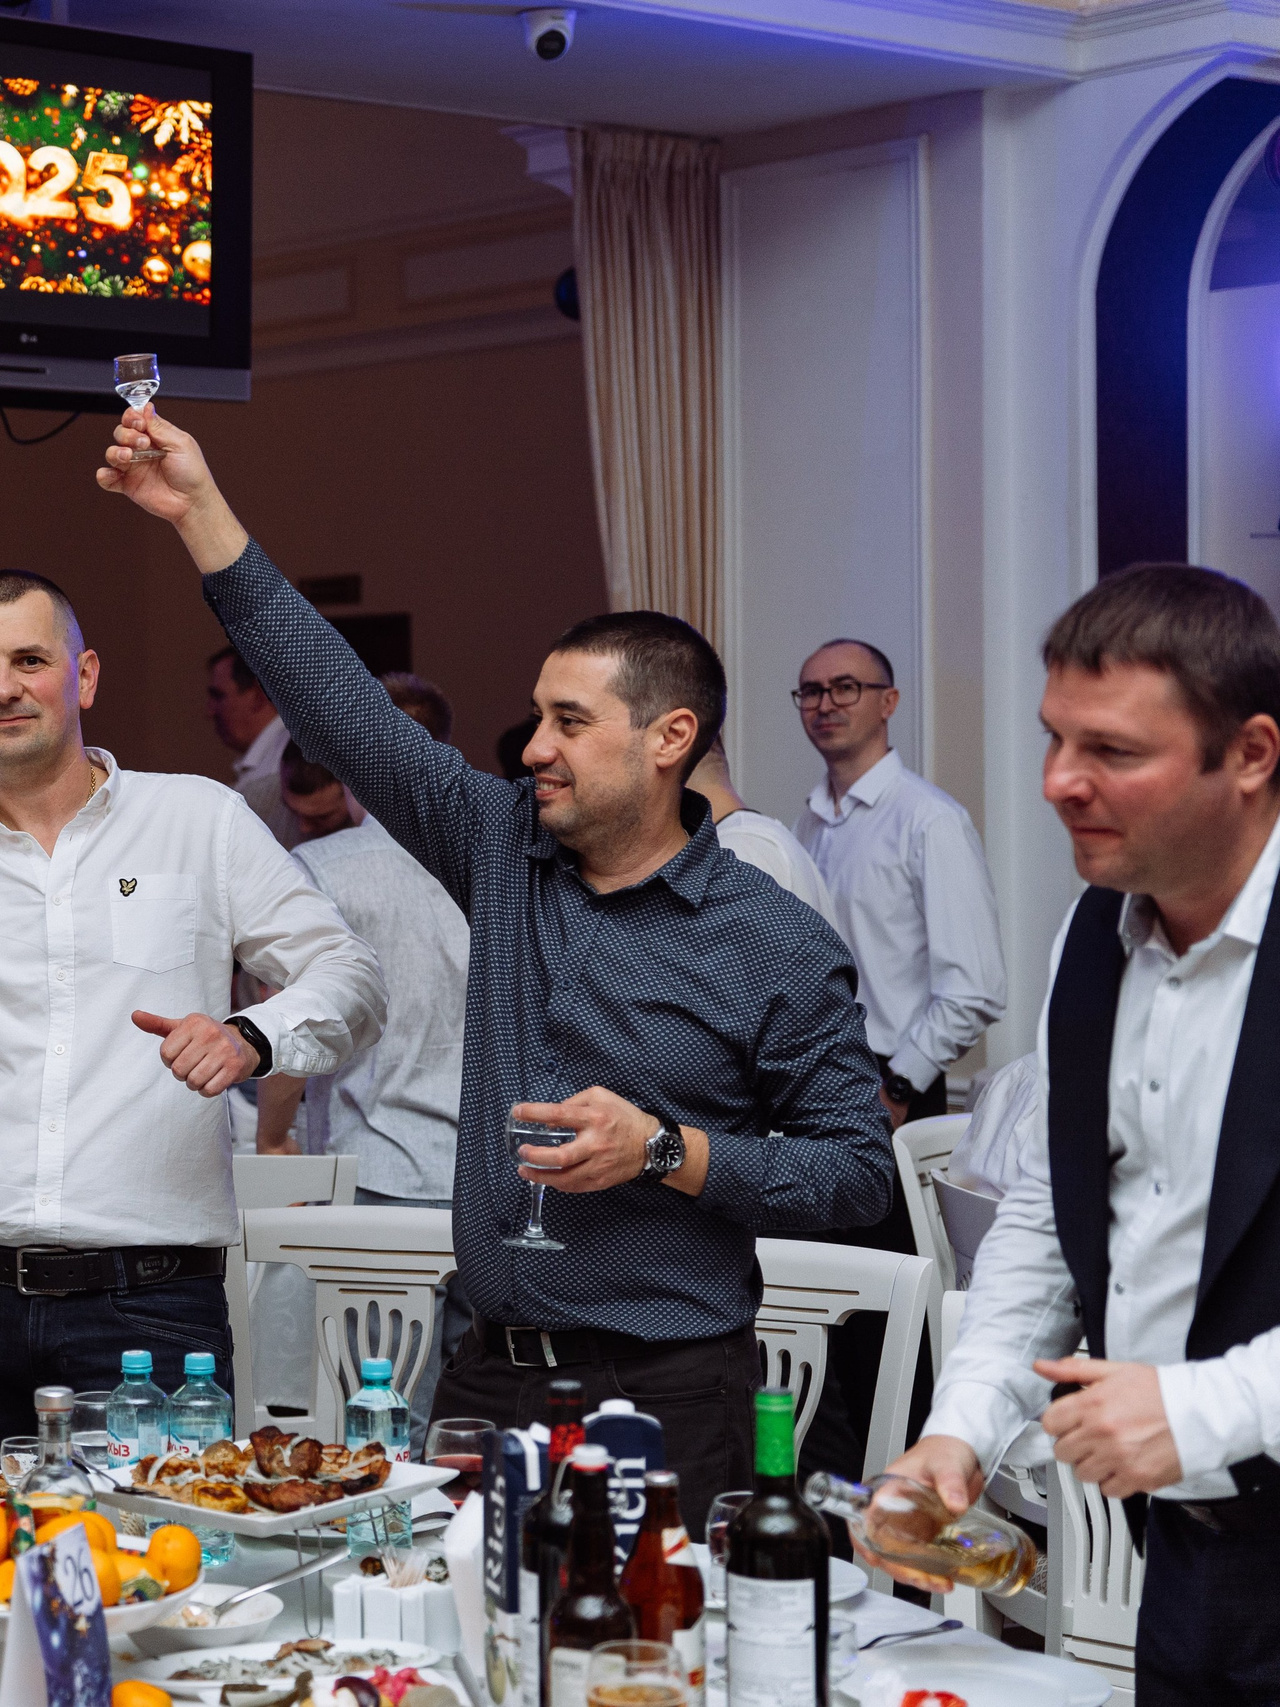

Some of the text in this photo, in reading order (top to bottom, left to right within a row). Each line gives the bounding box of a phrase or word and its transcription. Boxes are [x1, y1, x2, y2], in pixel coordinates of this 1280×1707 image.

[107, 1440, 130, 1457] ХЫЗ
[395, 1450, 410, 1462] АР
[484, 1474, 507, 1598] Rich
[64, 1548, 95, 1607] 26
